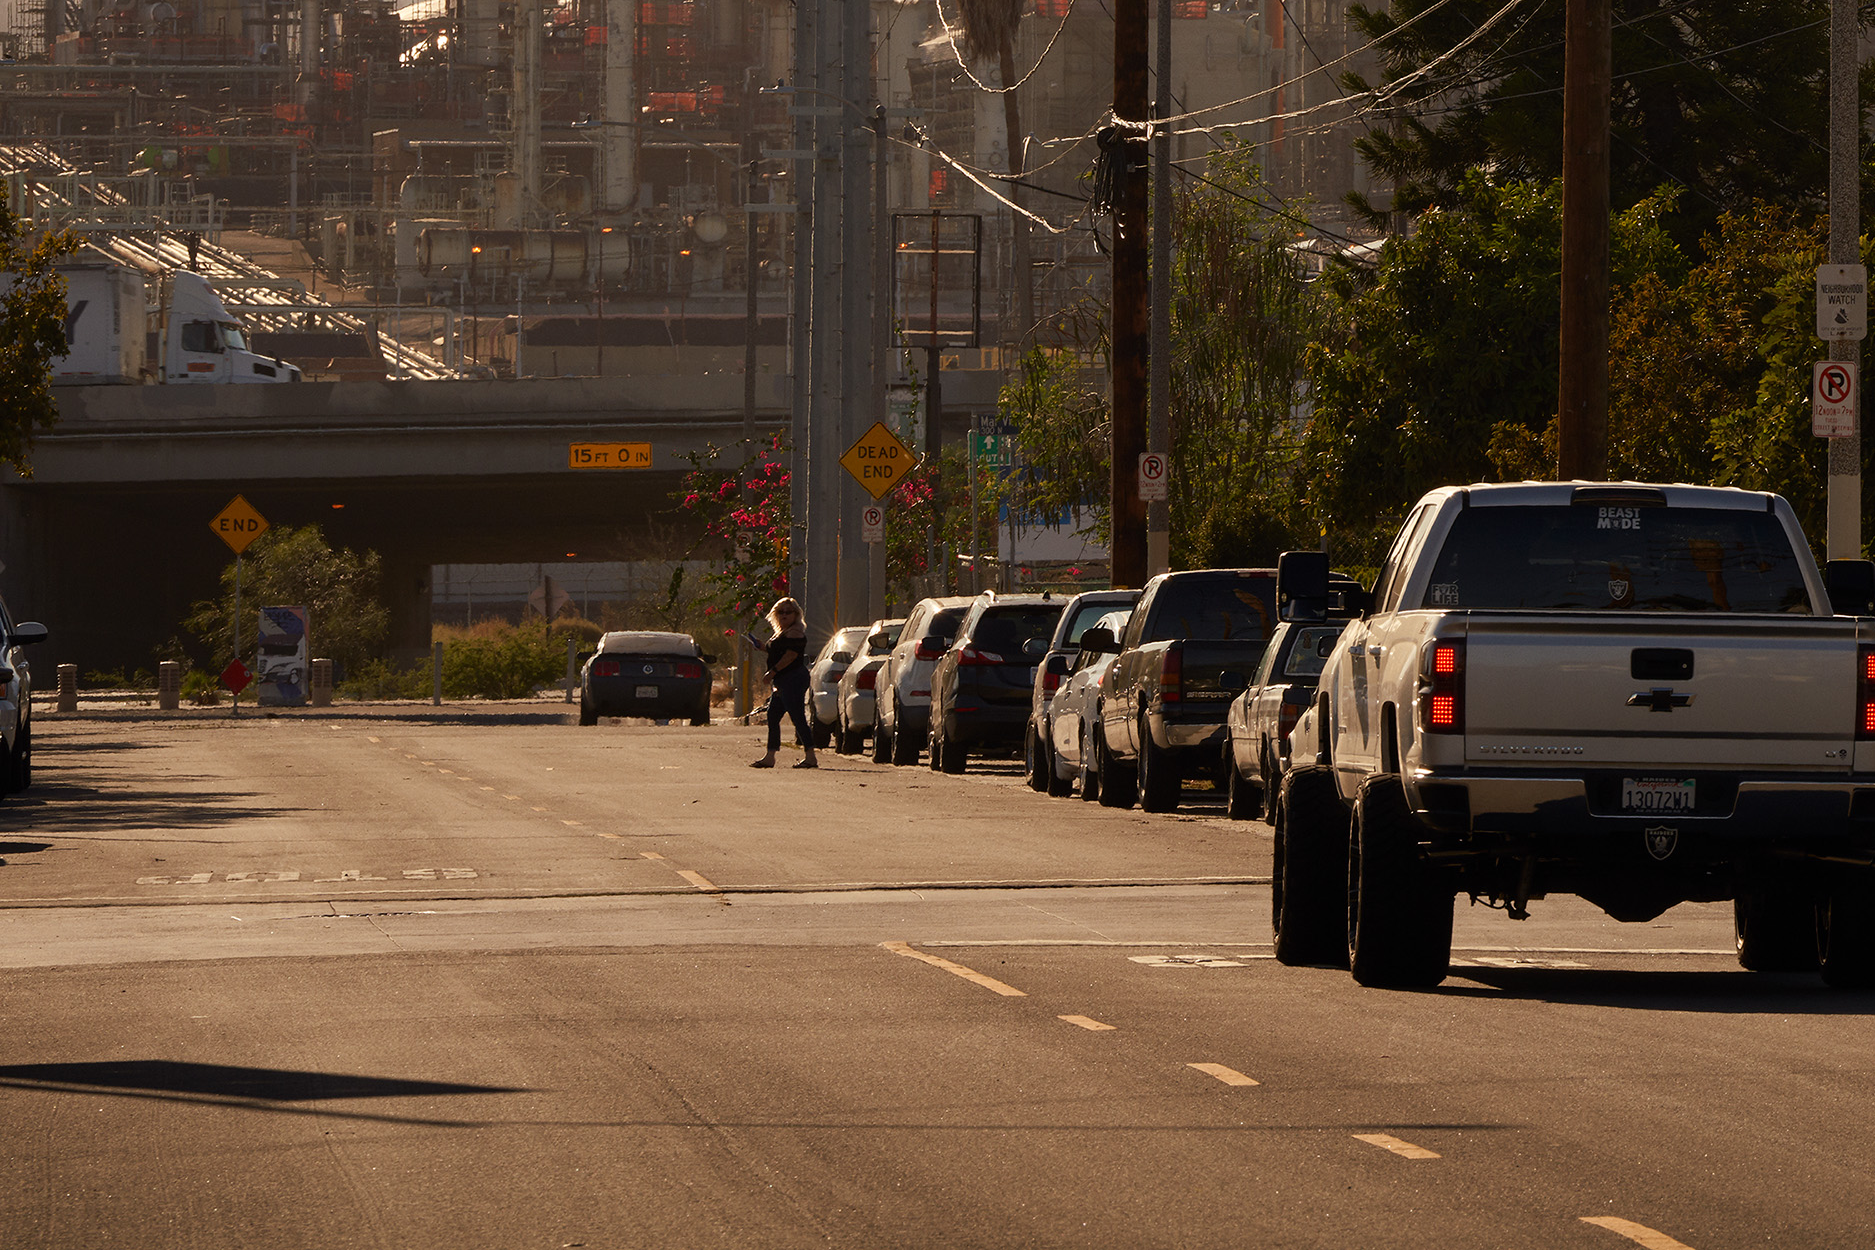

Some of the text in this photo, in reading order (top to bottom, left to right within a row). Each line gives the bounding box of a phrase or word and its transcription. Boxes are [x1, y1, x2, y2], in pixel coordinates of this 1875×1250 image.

[1828, 295, 1856, 304] WATCH
[574, 449, 648, 463] 15 FT 0 IN
[858, 446, 898, 459] DEAD
[863, 465, 893, 478] END
[1599, 507, 1640, 518] BEAST
[220, 518, 258, 532] END
[1480, 746, 1584, 755] SILVERADO
